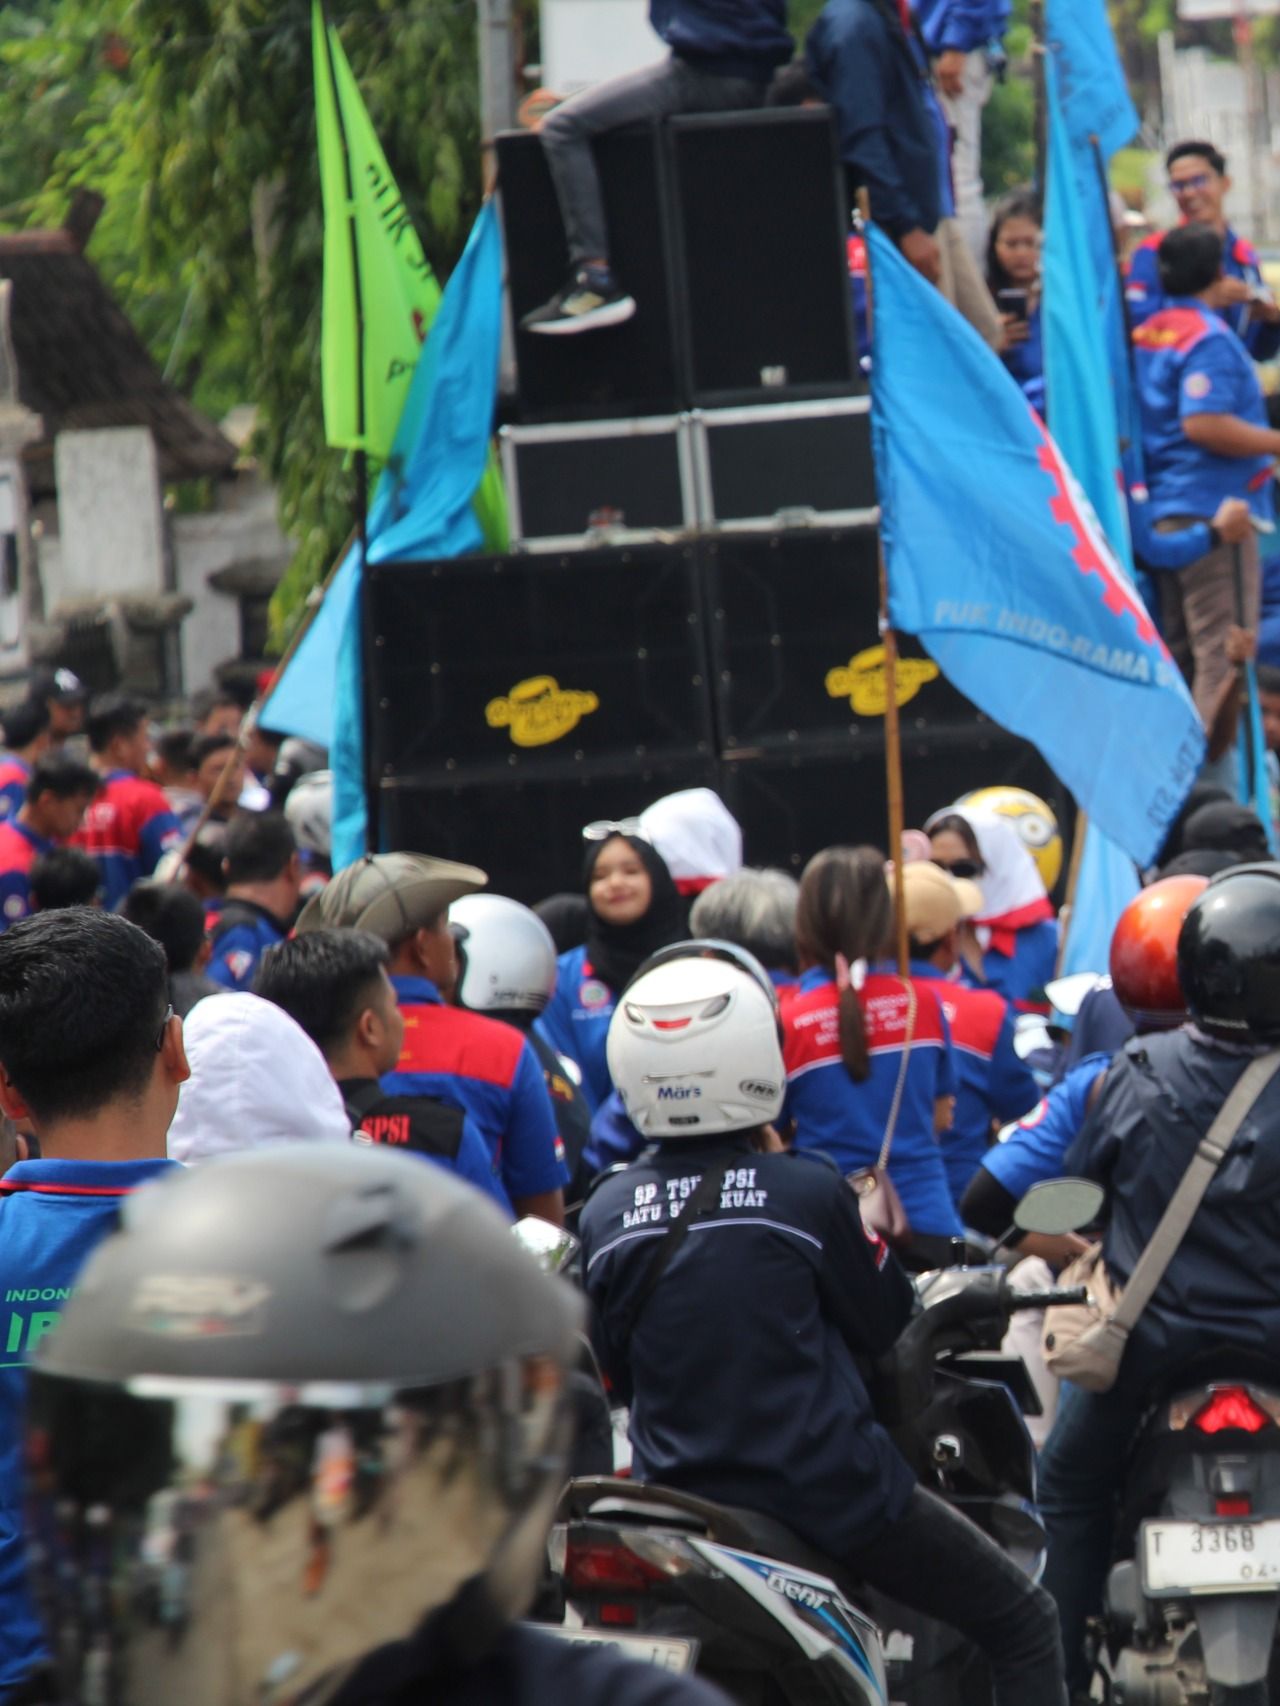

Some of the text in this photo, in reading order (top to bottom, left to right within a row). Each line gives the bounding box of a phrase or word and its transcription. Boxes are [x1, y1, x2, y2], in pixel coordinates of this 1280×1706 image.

[934, 600, 991, 626] PUK
[997, 609, 1149, 681] INDO-RAMA
[361, 1114, 411, 1144] SPSI
[635, 1183, 657, 1206] SP
[722, 1169, 757, 1190] PSI
[623, 1204, 662, 1228] SATU
[720, 1190, 767, 1208] KUAT
[1152, 1532, 1163, 1556] T
[1191, 1526, 1255, 1553] 3368
